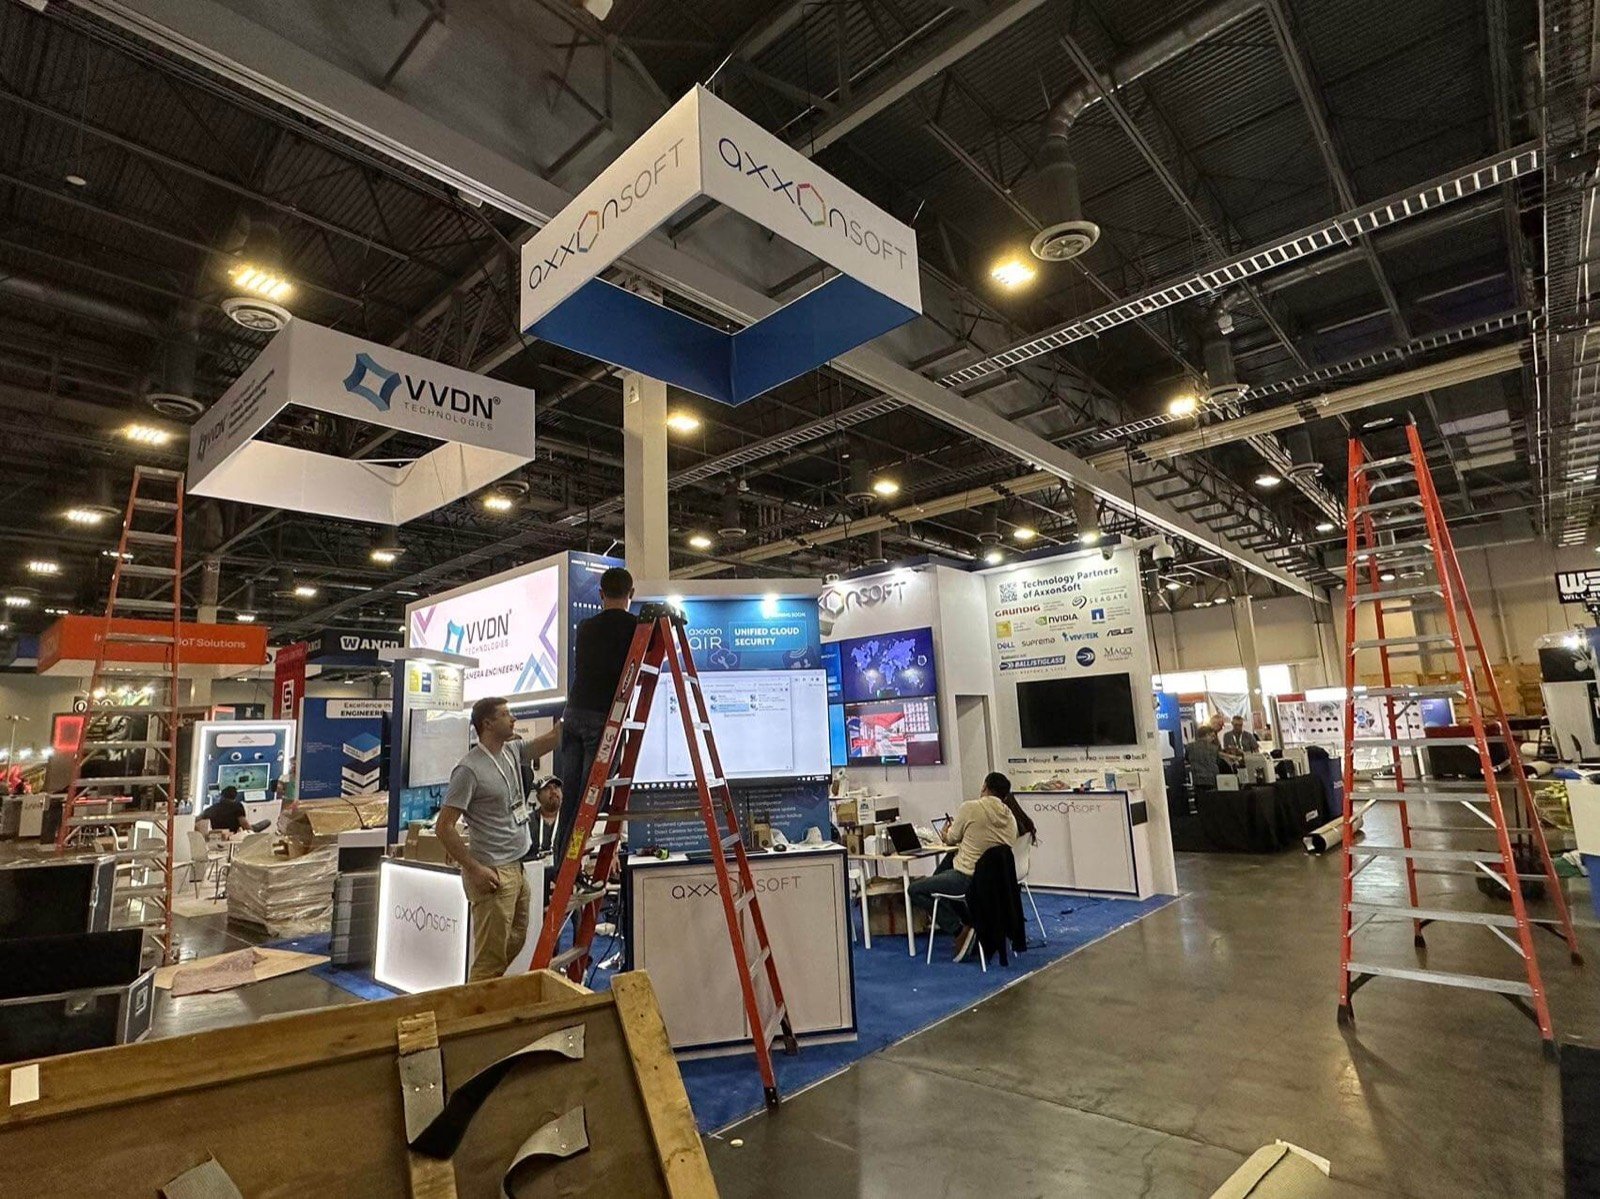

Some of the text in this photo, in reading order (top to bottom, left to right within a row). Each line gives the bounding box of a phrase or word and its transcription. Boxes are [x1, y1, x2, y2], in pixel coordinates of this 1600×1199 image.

[403, 401, 494, 431] TECHNOLOGIES
[1022, 567, 1119, 589] Technology Partners
[1023, 583, 1082, 599] of AxxonSoft
[1089, 592, 1128, 604] SEAGATE
[688, 628, 723, 636] axxon
[734, 627, 800, 636] UNIFIED CLOUD
[1107, 627, 1134, 637] ASUS
[197, 638, 246, 649] Solutions
[340, 635, 399, 651] WANCO
[735, 638, 776, 646] SECURITY
